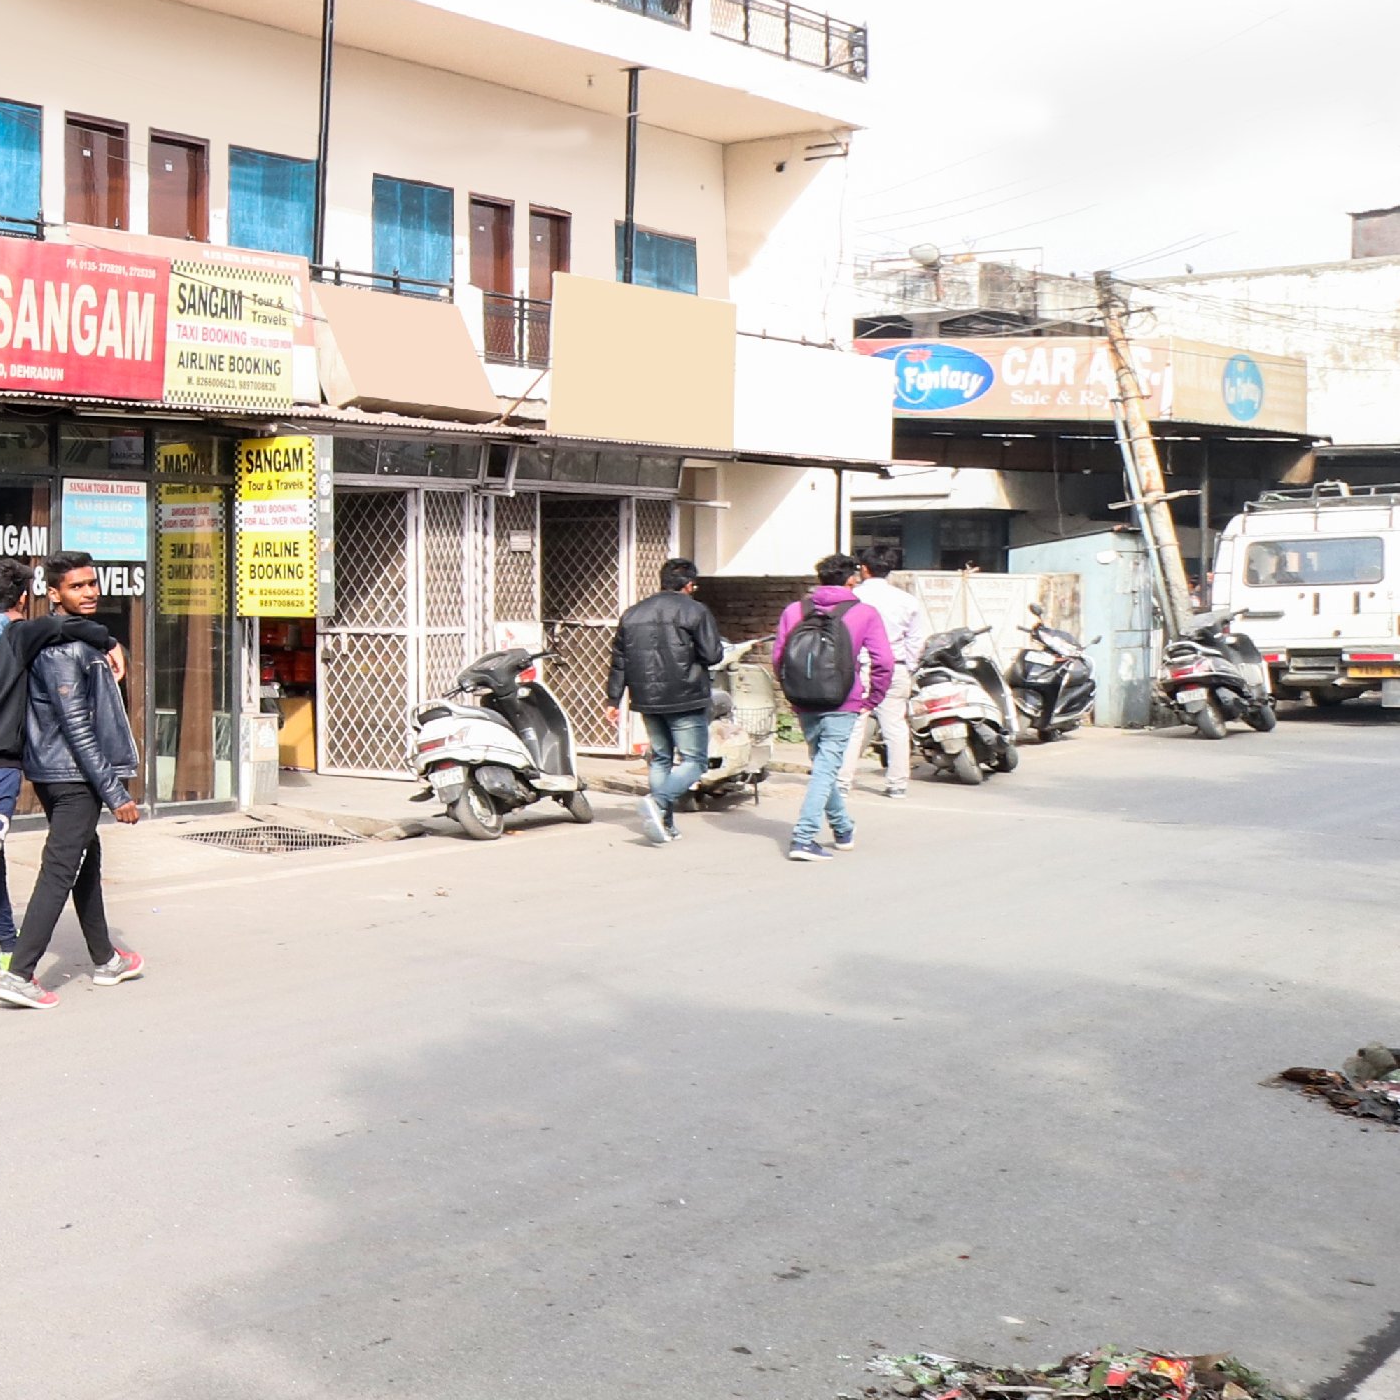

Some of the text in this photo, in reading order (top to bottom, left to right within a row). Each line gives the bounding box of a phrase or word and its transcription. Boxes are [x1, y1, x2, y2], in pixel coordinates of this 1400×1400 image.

[176, 282, 285, 321] SANGAM Tour &
[252, 311, 287, 327] Travels
[176, 324, 199, 341] TAXI
[201, 326, 247, 346] BOOKING
[177, 350, 281, 376] AIRLINE BOOKING
[1001, 346, 1077, 386] CAR
[10, 364, 64, 382] DEHRADUN
[904, 365, 984, 398] Fantasy
[1010, 390, 1051, 405] Sale
[1056, 390, 1071, 405] &
[245, 448, 304, 474] SANGAM
[247, 479, 304, 491] Tour & Travels
[253, 504, 297, 514] TAXI BOOKING
[244, 516, 307, 526] FOR ALL OVER INDIA
[253, 541, 299, 558] AIRLINE
[249, 563, 304, 580] BOOKING
[33, 566, 46, 596] &
[93, 566, 145, 596] VELS
